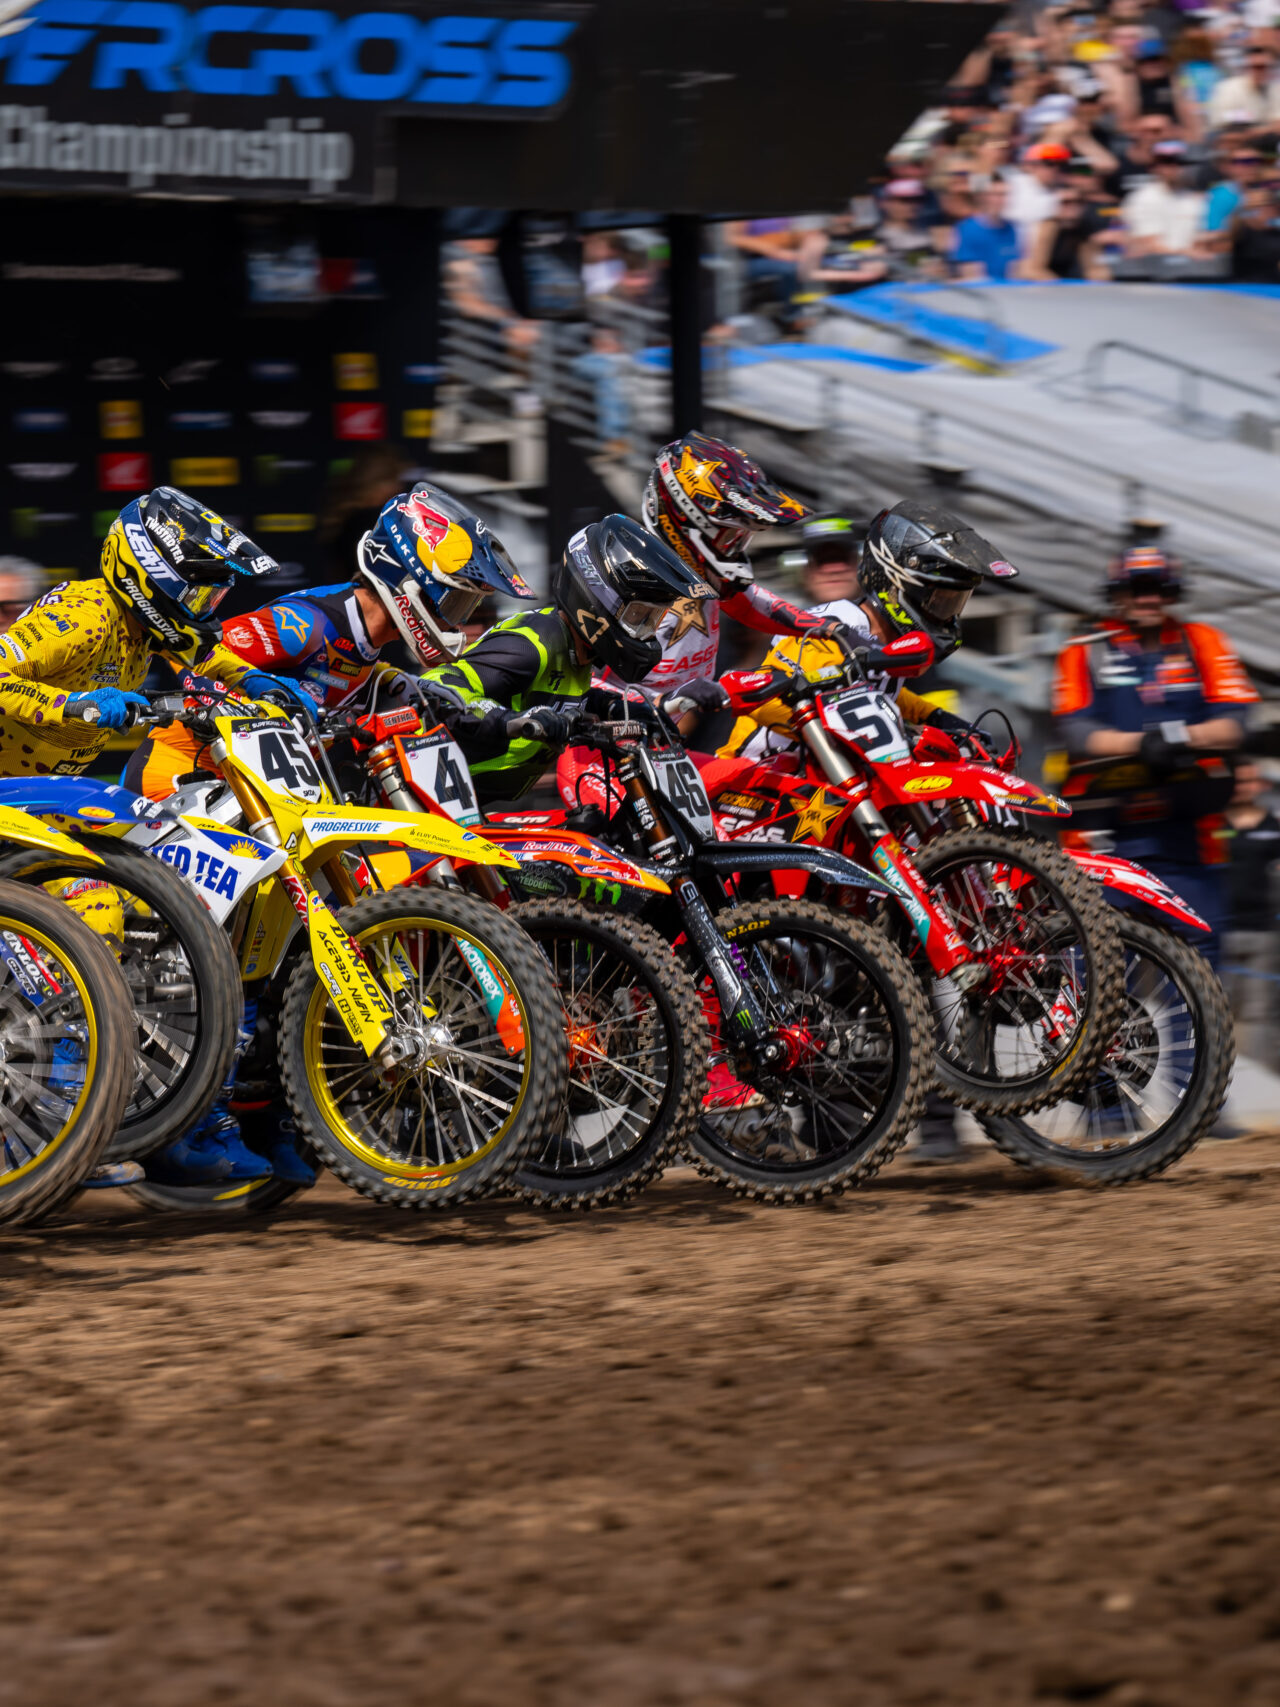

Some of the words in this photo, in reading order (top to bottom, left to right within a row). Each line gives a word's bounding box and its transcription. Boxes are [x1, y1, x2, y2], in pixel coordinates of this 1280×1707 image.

[146, 517, 177, 551] TWISTED
[171, 547, 185, 564] TEA
[391, 524, 435, 585] OAKLEY
[121, 577, 181, 644] PROGRESSIVE
[395, 593, 421, 631] Red
[413, 624, 443, 660] Bull
[1, 682, 37, 700] TWISTED
[34, 690, 51, 706] TEA
[383, 711, 416, 728] RENTHAL
[258, 730, 322, 789] 45
[434, 747, 474, 811] 4
[666, 760, 711, 819] 46
[310, 820, 382, 833] PROGRESSIVE
[195, 850, 240, 902] TEA
[317, 930, 350, 983] ACERBIS
[724, 919, 771, 940] NLOP
[330, 924, 387, 1014] DUNLOP
[460, 938, 502, 1000] MOTOREX
[347, 986, 376, 1024] NISSIN
